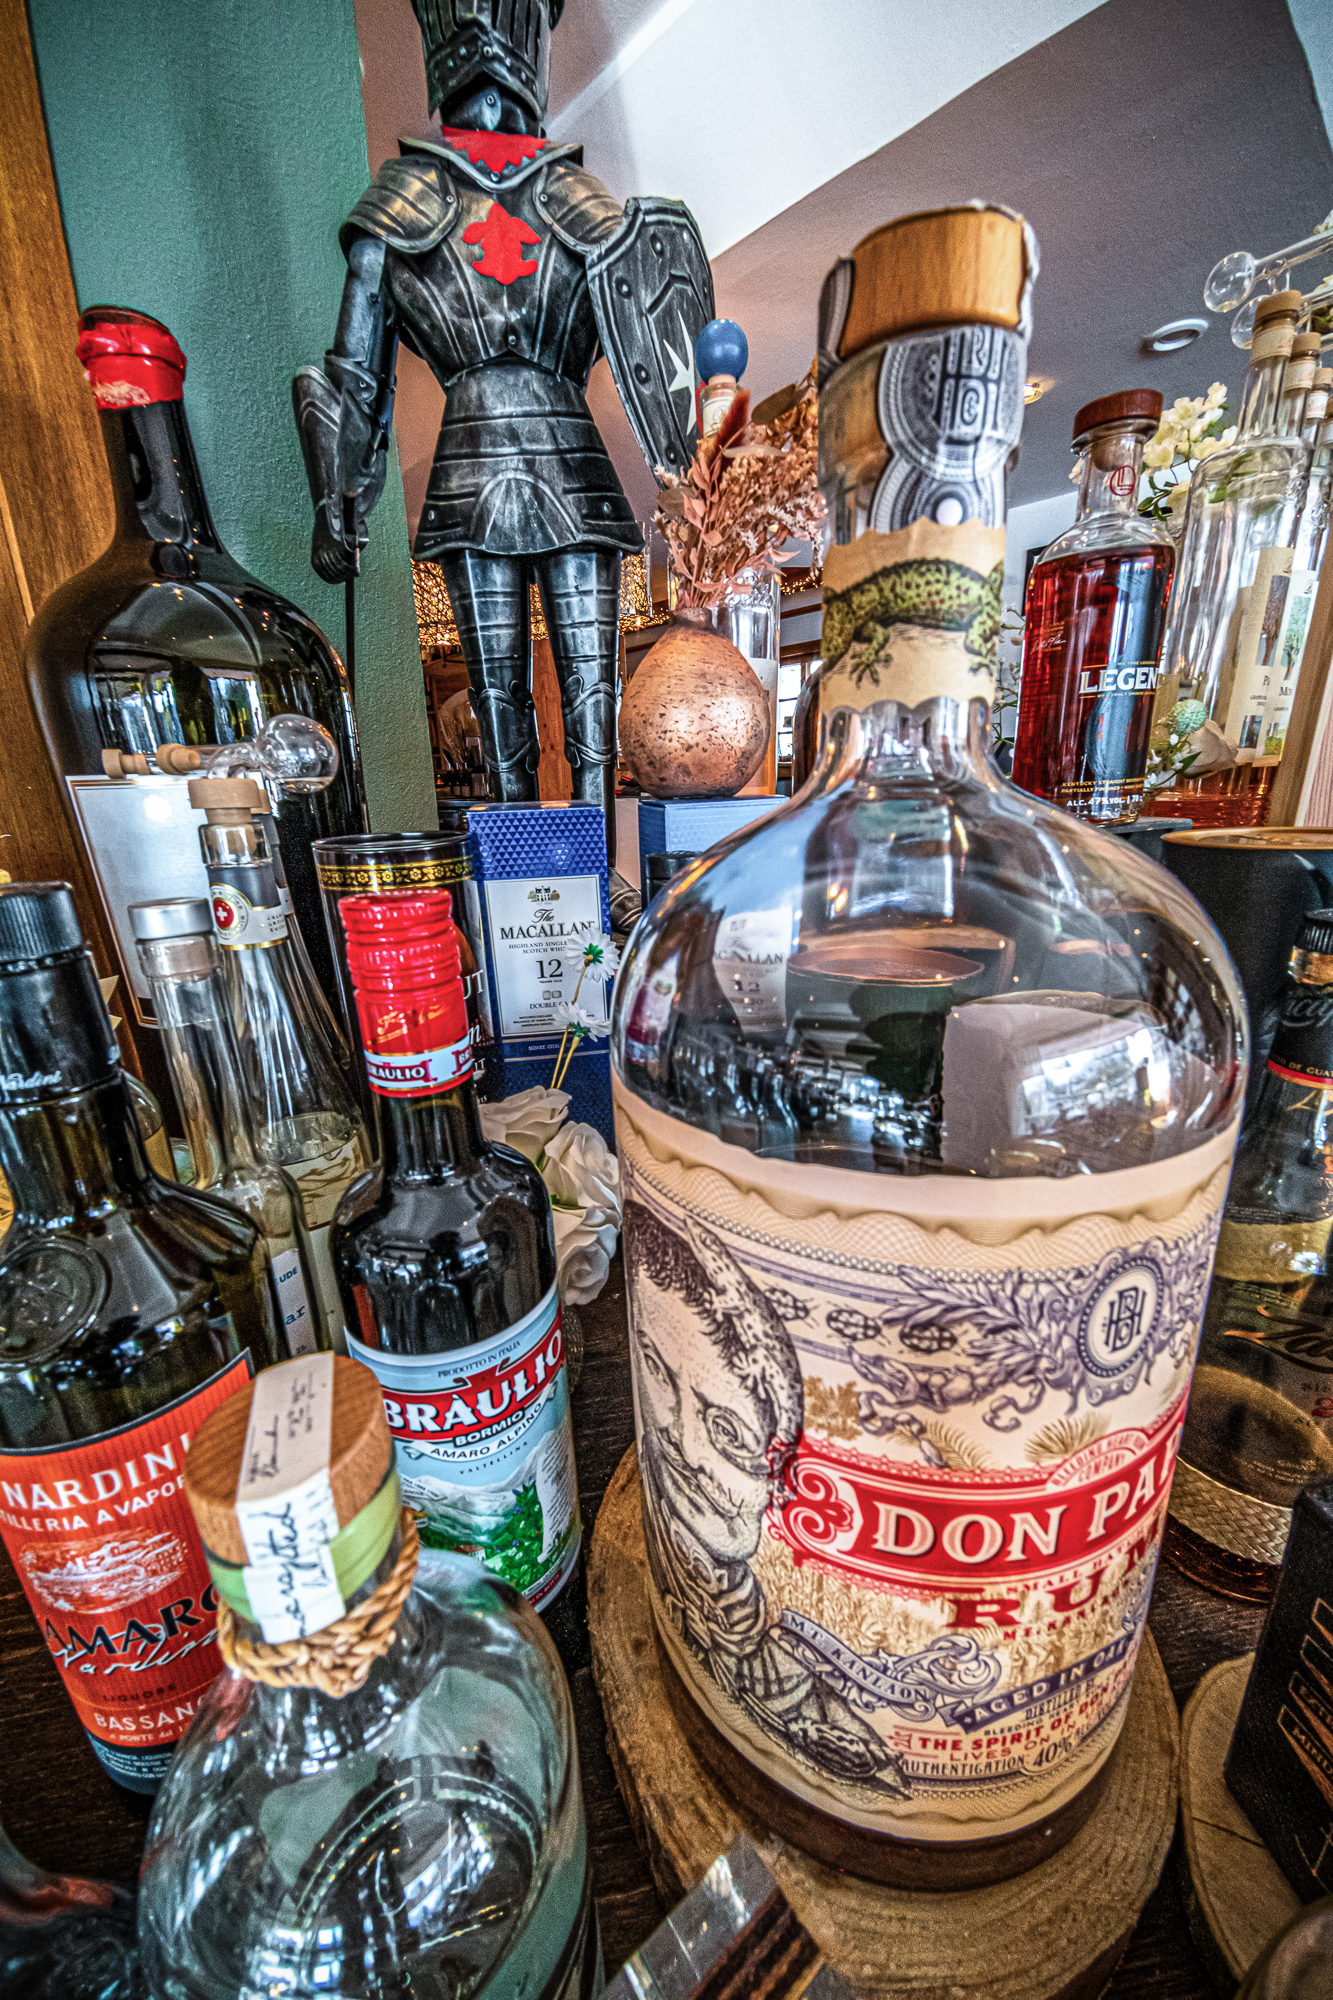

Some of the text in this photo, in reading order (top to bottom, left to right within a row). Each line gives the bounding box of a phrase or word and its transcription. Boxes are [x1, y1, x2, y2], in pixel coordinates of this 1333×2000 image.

[1079, 667, 1160, 693] LEGEN
[1066, 799, 1087, 807] ALC.
[531, 908, 554, 924] The
[508, 942, 544, 950] HIGHLAND
[522, 947, 548, 955] SCOTCH
[536, 959, 563, 980] 12
[529, 1002, 556, 1010] DOUBLE
[367, 1061, 426, 1080] RAULIO
[437, 1341, 521, 1378] PRODOTTO IN ITALIA
[430, 1402, 542, 1459] AMARO ALPINO
[455, 1411, 523, 1446] BORMIO
[459, 1441, 528, 1475] VALTELLINA
[97, 1509, 114, 1525] A
[872, 1500, 1068, 1564] DON
[945, 1514, 1158, 1629] RUM
[1005, 1570, 1080, 1596] SMALL
[974, 1682, 1048, 1722] AGED
[1059, 1664, 1086, 1686] IN
[94, 1701, 198, 1731] BASSAN
[984, 1717, 1044, 1737] BLEEDING
[918, 1737, 963, 1751] THE
[971, 1726, 1044, 1750] SPIRIT
[949, 1747, 1001, 1762] LIVES
[1025, 1734, 1051, 1751] ON
